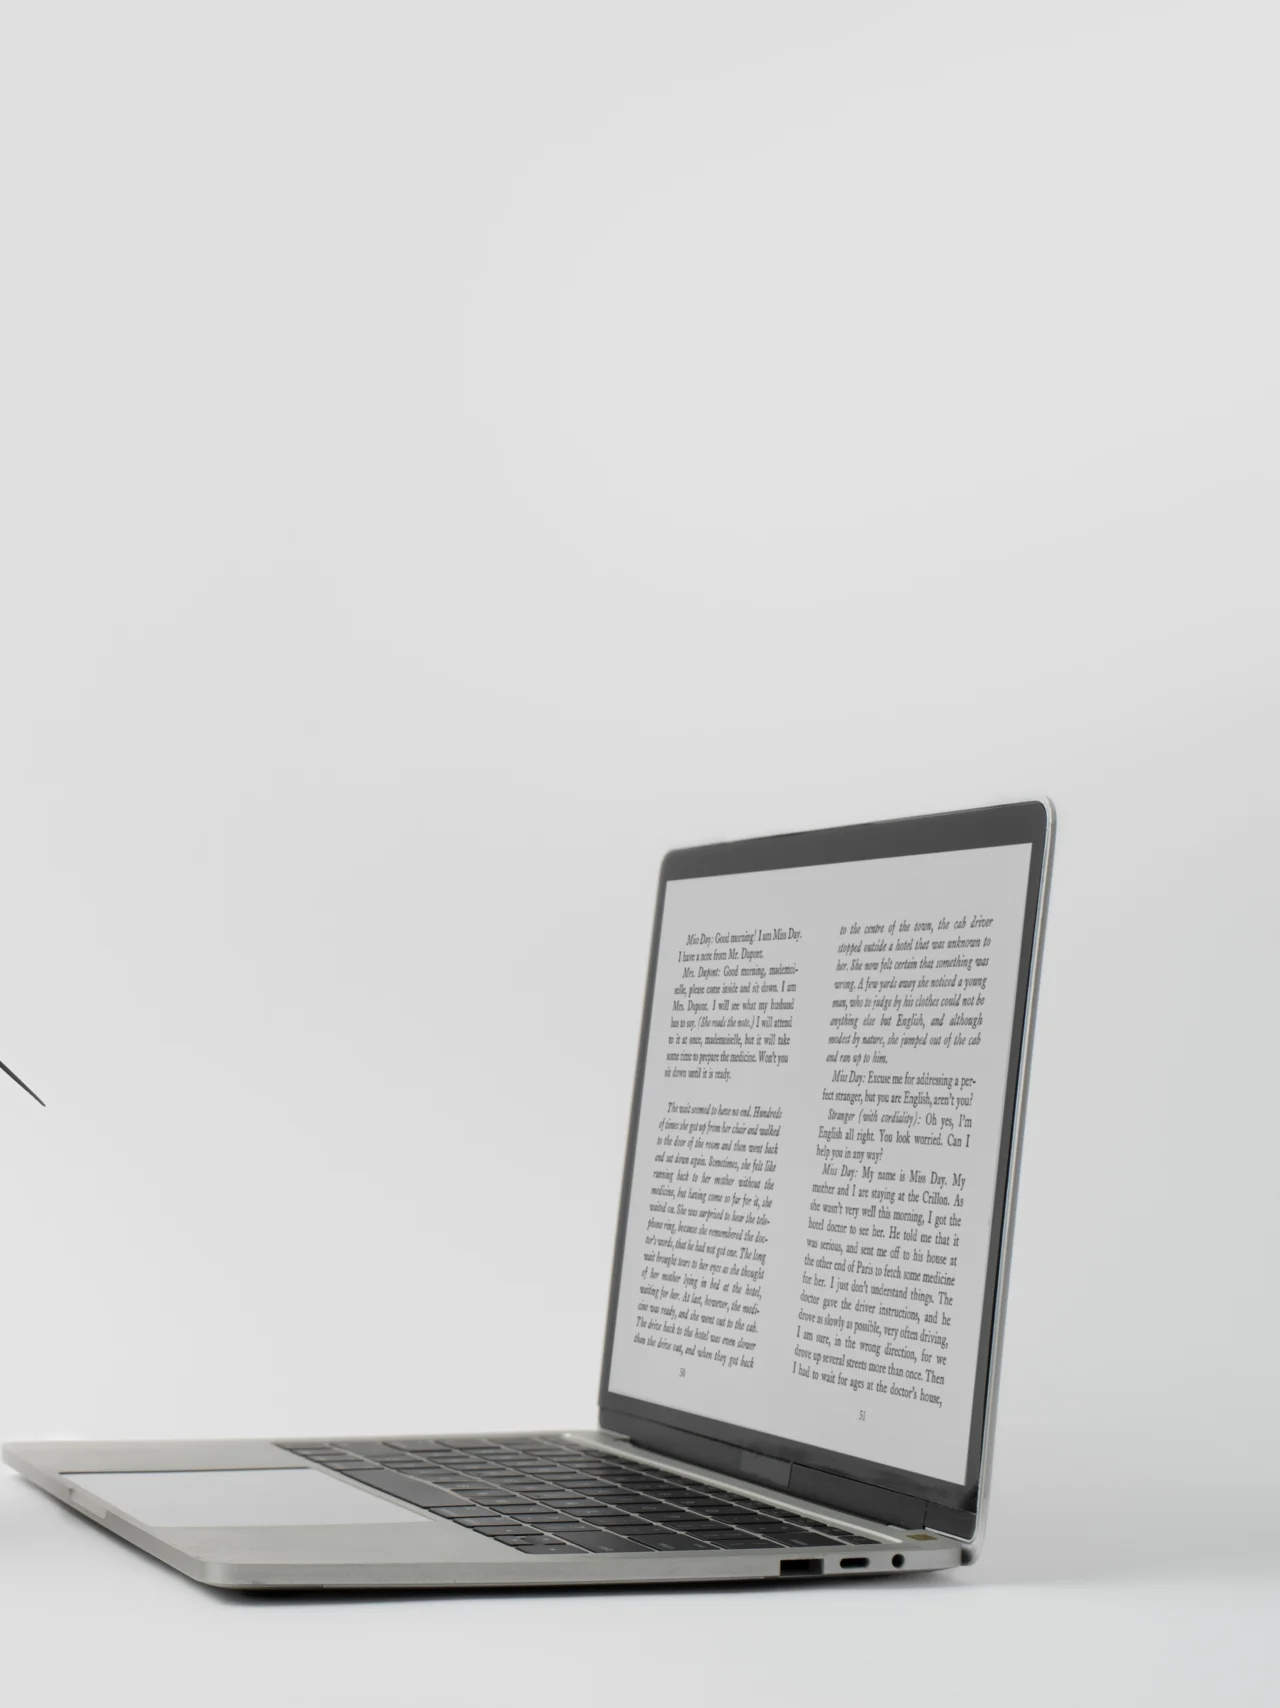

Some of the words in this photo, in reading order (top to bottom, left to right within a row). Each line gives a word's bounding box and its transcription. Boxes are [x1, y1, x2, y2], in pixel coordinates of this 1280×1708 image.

[839, 926, 847, 936] to
[849, 922, 861, 935] the
[864, 924, 885, 934] centre
[888, 920, 897, 936] of
[898, 920, 911, 933] the
[937, 917, 950, 930] the
[953, 916, 967, 929] cab
[970, 915, 994, 929] driver
[850, 958, 863, 971] She
[864, 962, 879, 971] now
[879, 957, 893, 973] felt
[894, 957, 918, 970] certain
[919, 956, 934, 969] that
[935, 954, 973, 971] something
[975, 958, 990, 967] was
[829, 1013, 859, 1030] anything
[862, 1014, 876, 1026] else
[880, 1013, 892, 1026] but
[930, 1013, 946, 1027] and
[949, 1012, 983, 1030] although
[831, 1069, 848, 1083] Miss
[867, 1070, 891, 1084] Excuse
[892, 1075, 903, 1085] me
[904, 1071, 915, 1085] for
[916, 1072, 953, 1090] addressing
[954, 1077, 959, 1087] a
[822, 1088, 834, 1101] fect
[864, 1089, 876, 1103] but
[876, 1094, 890, 1106] you
[890, 1094, 902, 1104] are
[827, 1108, 856, 1125] Stranger
[925, 1112, 937, 1126] Oh
[818, 1125, 843, 1143] English
[845, 1128, 855, 1141] all
[879, 1129, 893, 1143] You
[895, 1130, 911, 1144] look
[947, 1133, 962, 1147] Can
[965, 1134, 971, 1148] I
[812, 1181, 836, 1195] mother
[836, 1184, 850, 1196] and
[852, 1184, 856, 1197] I
[858, 1188, 869, 1198] are
[871, 1187, 896, 1205] staying
[897, 1192, 905, 1202] at
[908, 1189, 920, 1203] the
[953, 1193, 964, 1207] As
[810, 1198, 821, 1212] she
[845, 1206, 860, 1220] very
[861, 1205, 877, 1218] well
[878, 1205, 891, 1220] this
[927, 1210, 933, 1224] I
[934, 1216, 947, 1229] got
[949, 1212, 962, 1227] the
[806, 1239, 818, 1249] was
[845, 1241, 859, 1254] and
[860, 1246, 874, 1256] sent
[876, 1248, 888, 1258] me
[889, 1245, 901, 1259] off
[902, 1250, 910, 1261] to
[912, 1248, 924, 1262] his
[926, 1250, 947, 1265] house
[949, 1257, 958, 1267] at
[802, 1271, 812, 1285] for
[830, 1276, 835, 1289] I
[835, 1277, 849, 1293] just
[871, 1283, 908, 1300] understand
[938, 1291, 953, 1306] The
[800, 1289, 820, 1305] doctor
[822, 1298, 838, 1310] gave
[841, 1297, 852, 1310] the
[854, 1299, 876, 1314] driver
[924, 1311, 938, 1324] and
[941, 1312, 951, 1326] he
[792, 1361, 797, 1374] I
[798, 1363, 810, 1378] had
[812, 1370, 819, 1380] to
[821, 1371, 836, 1384] wait
[837, 1372, 848, 1386] for
[849, 1378, 865, 1392] ages
[866, 1382, 874, 1391] at
[876, 1380, 888, 1394] the
[859, 1410, 866, 1421] 51
